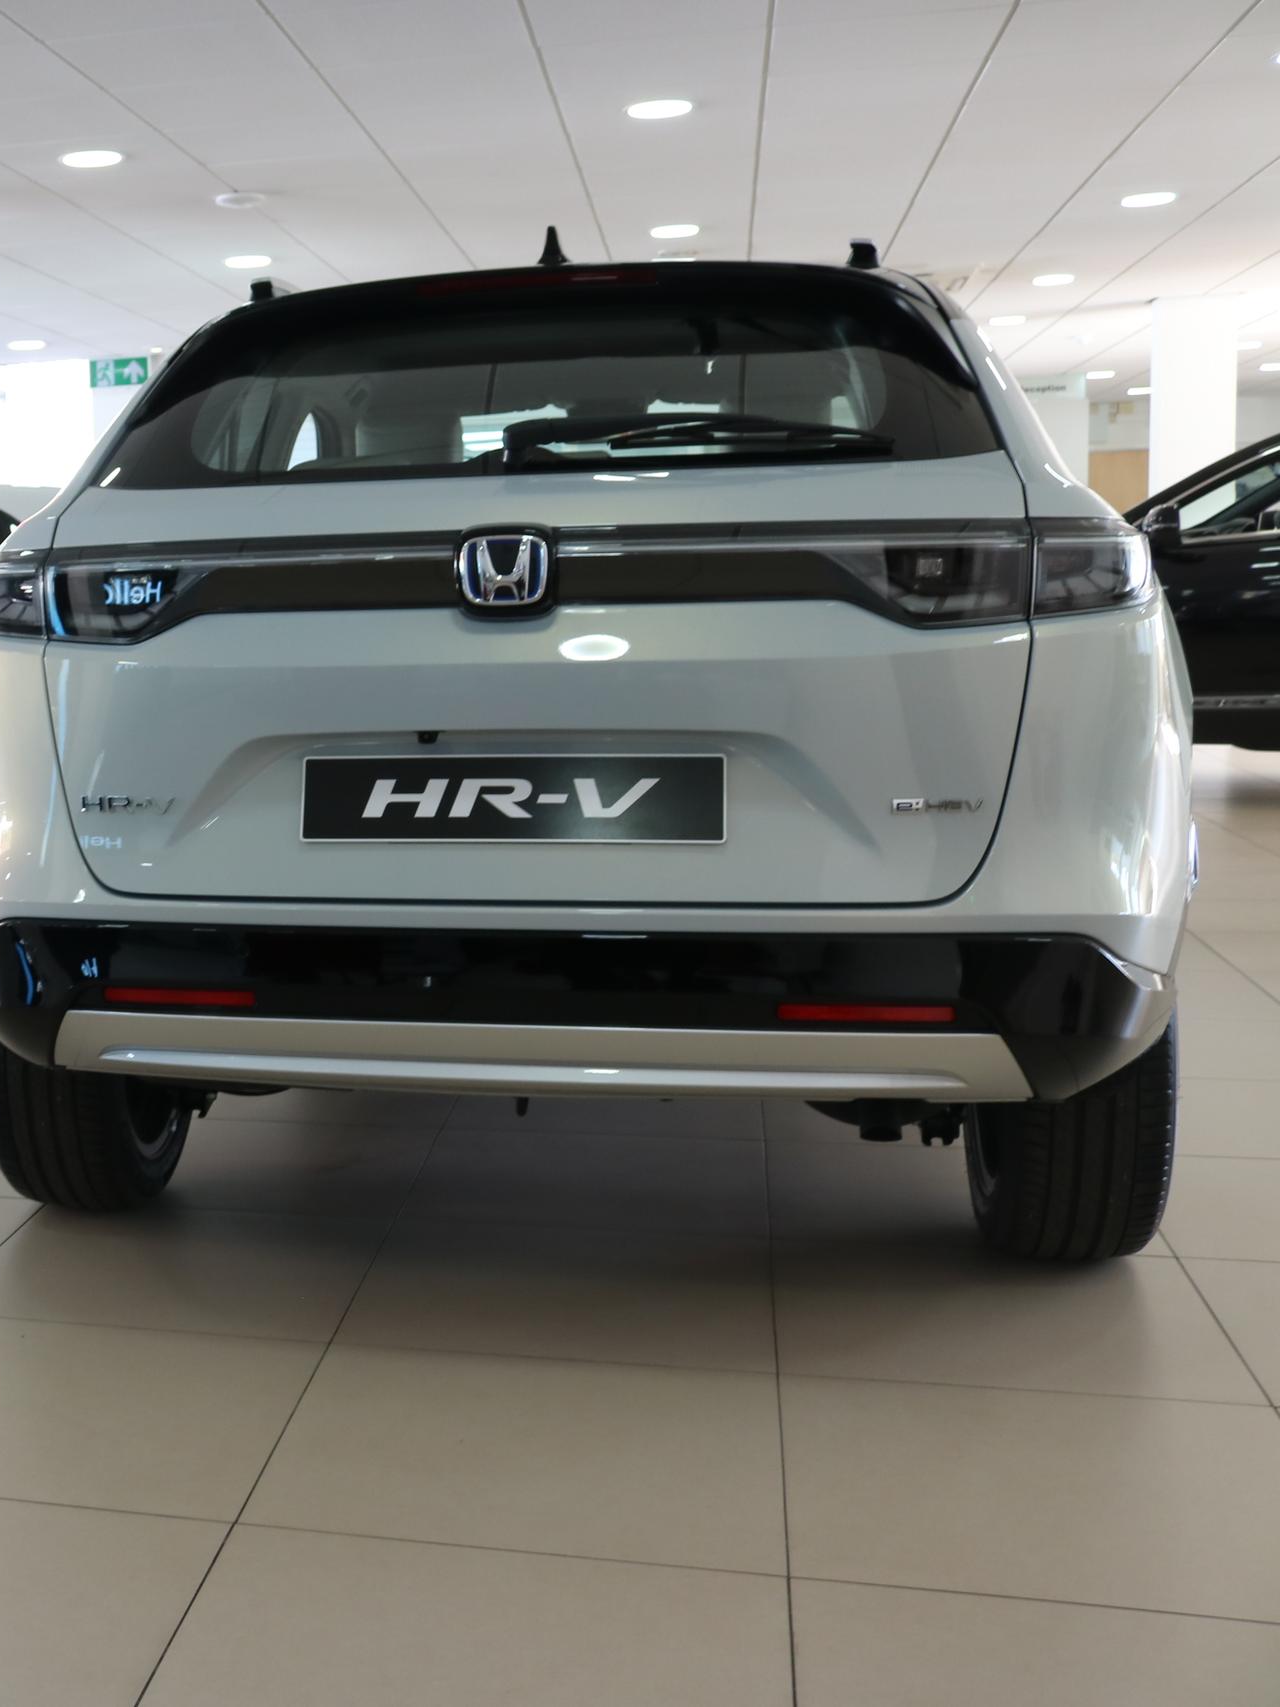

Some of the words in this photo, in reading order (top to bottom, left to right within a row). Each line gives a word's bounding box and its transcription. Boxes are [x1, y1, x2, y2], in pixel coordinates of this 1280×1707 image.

[1021, 384, 1066, 394] eception
[81, 795, 176, 815] HR-V
[361, 777, 661, 818] HR-V
